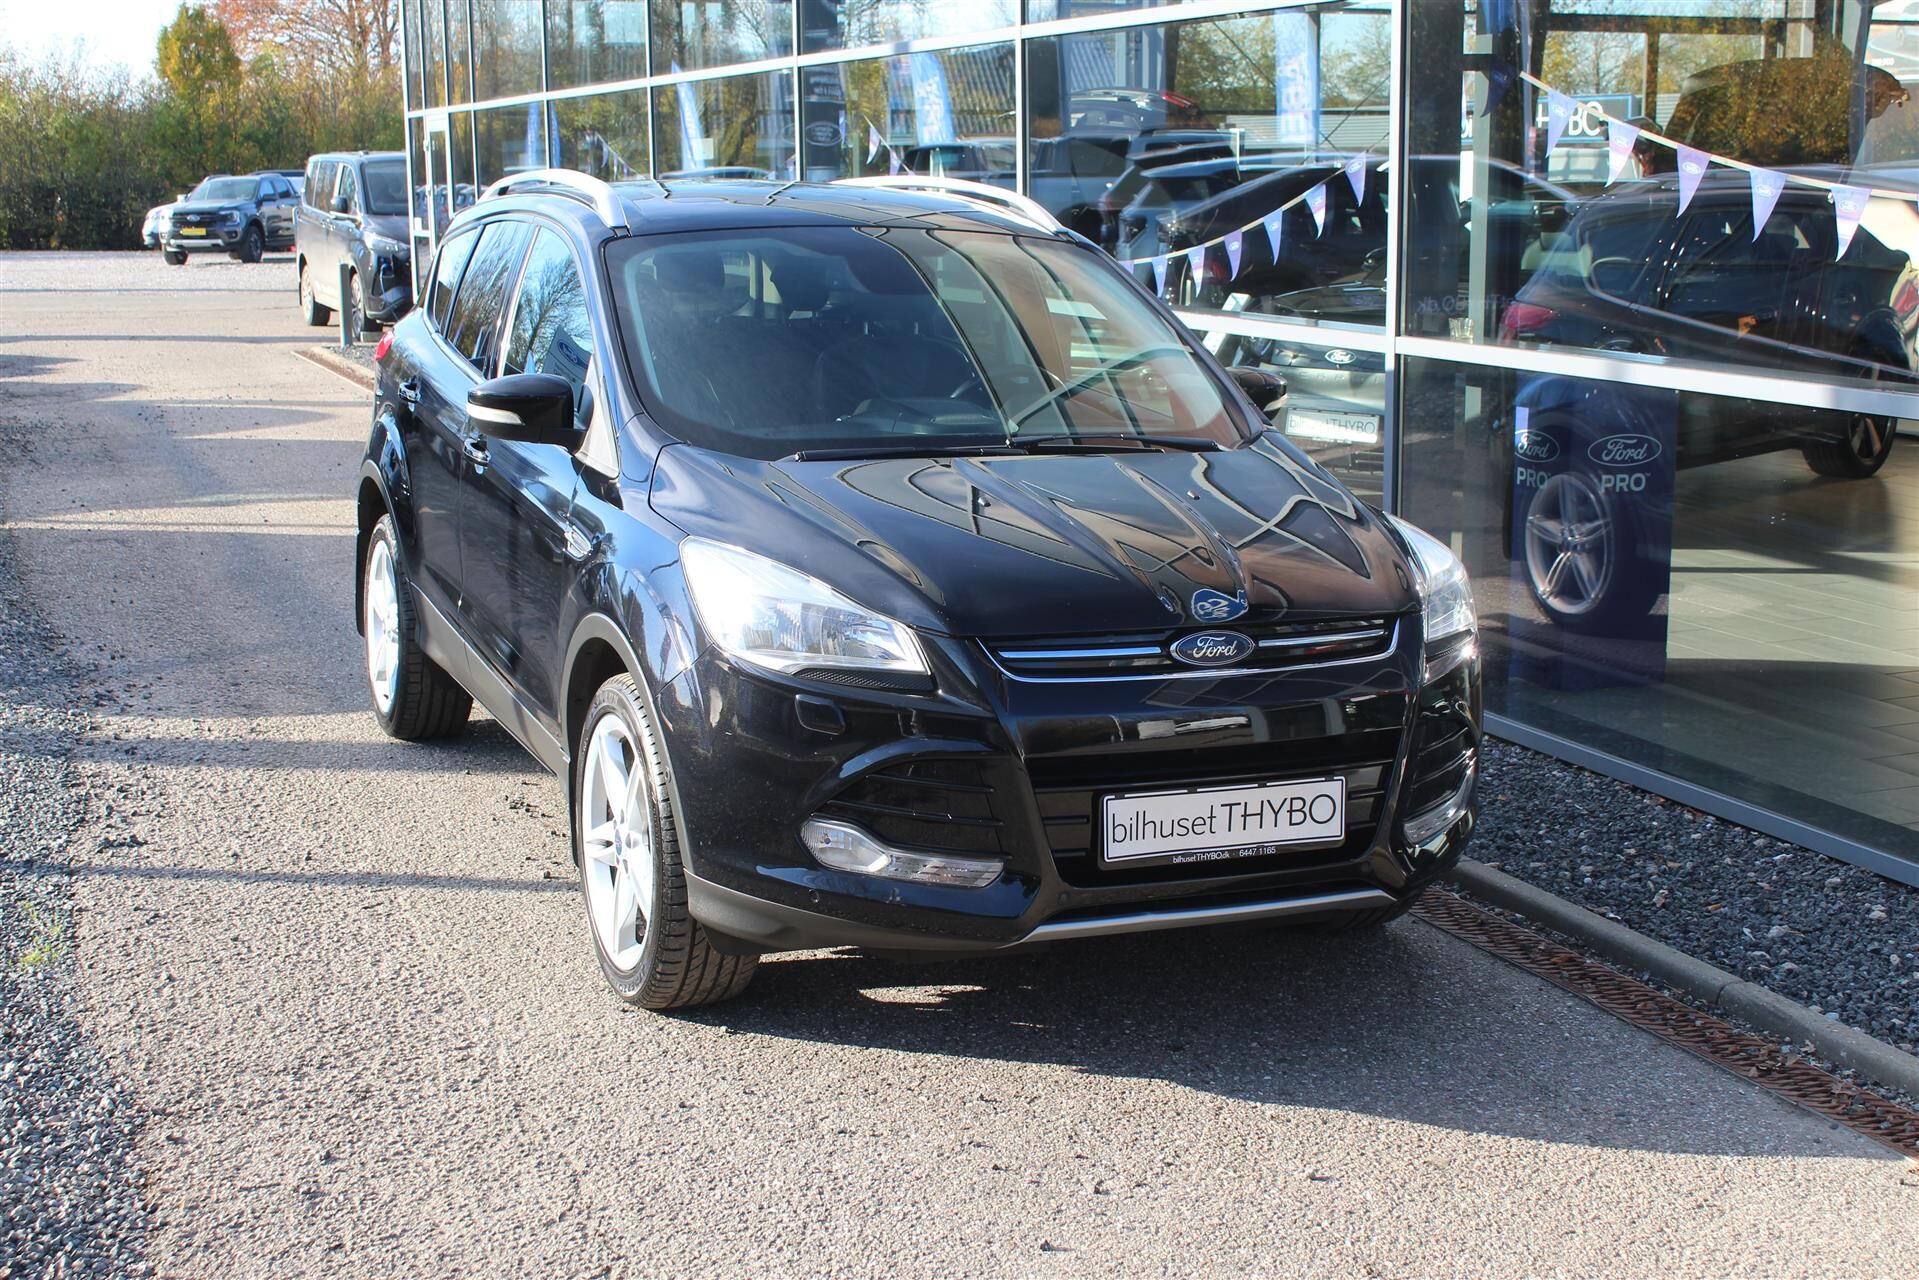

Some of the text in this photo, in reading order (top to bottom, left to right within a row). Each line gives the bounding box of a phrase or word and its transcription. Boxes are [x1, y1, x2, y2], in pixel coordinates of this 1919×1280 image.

[1517, 435, 1550, 459] Ford
[1602, 438, 1649, 461] Ford
[1193, 636, 1237, 658] Ford
[1239, 847, 1257, 858] 6447
